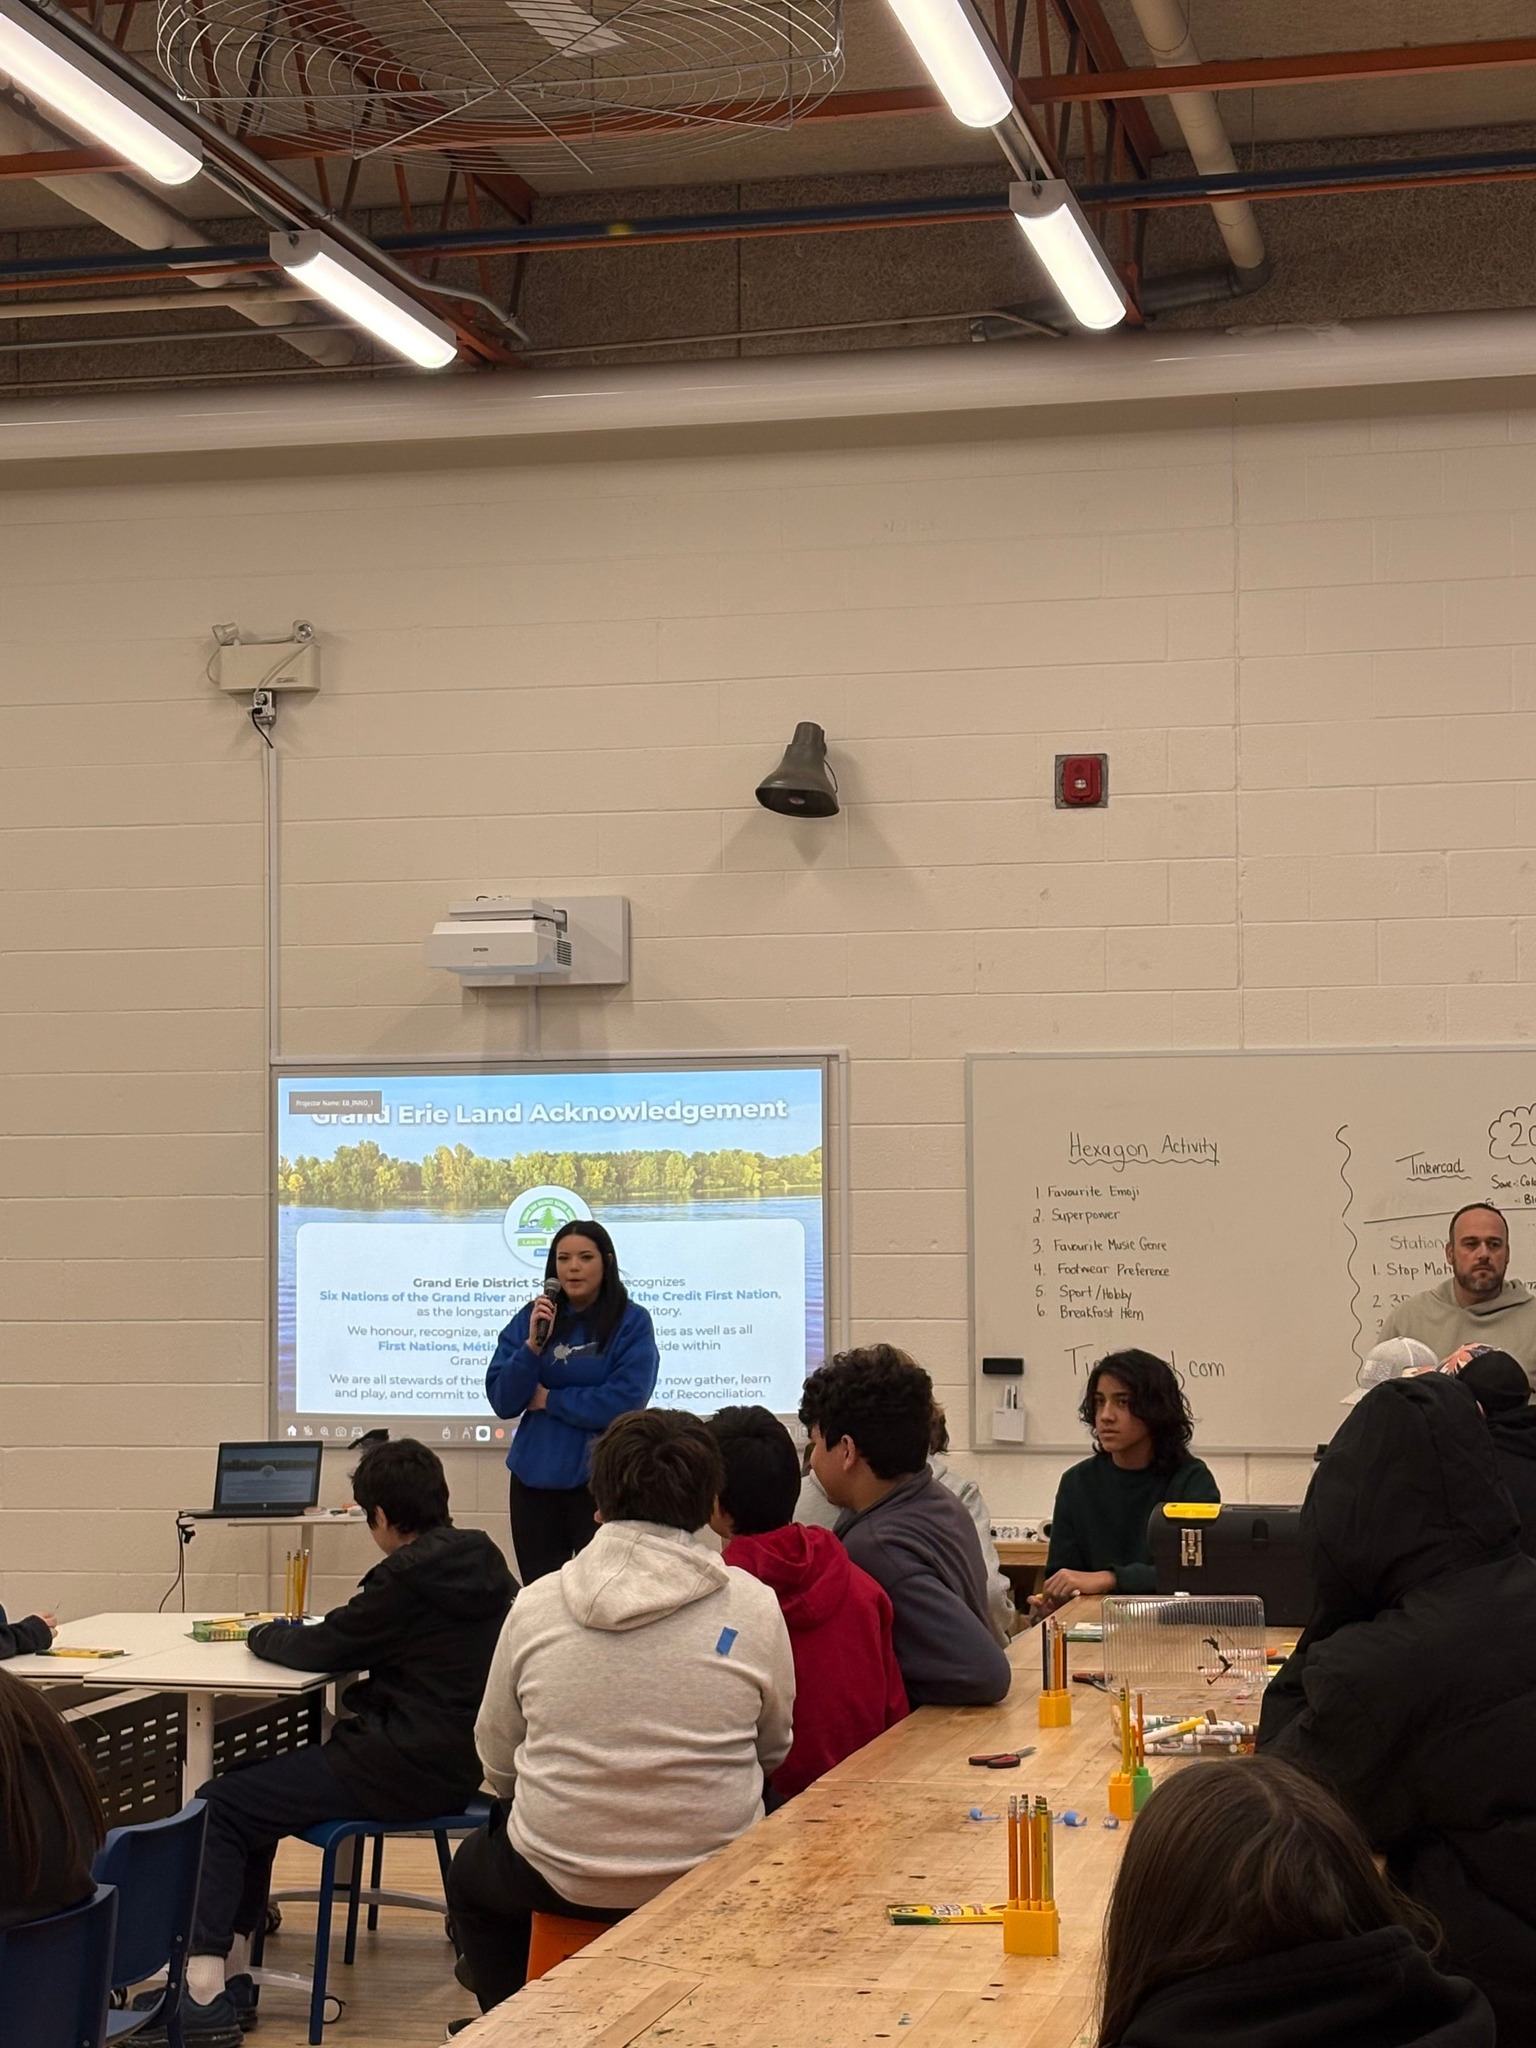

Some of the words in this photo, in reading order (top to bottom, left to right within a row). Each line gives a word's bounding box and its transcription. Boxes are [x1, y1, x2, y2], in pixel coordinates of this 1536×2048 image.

[398, 1104, 449, 1124] Erie
[456, 1103, 522, 1124] Land
[528, 1099, 788, 1125] Acknowledgement
[1069, 1131, 1149, 1172] Hexagon
[1161, 1134, 1218, 1166] Activity
[1395, 1151, 1465, 1175] Tinkercad
[1047, 1185, 1103, 1197] Favourite
[1109, 1185, 1140, 1201] Emoji
[1053, 1239, 1103, 1252] Favourite
[1107, 1239, 1136, 1251] Music
[1139, 1236, 1167, 1251] Genre
[1057, 1263, 1110, 1275] Footwear
[1117, 1262, 1170, 1277] Preference
[1386, 1262, 1419, 1280] Stop
[413, 1278, 451, 1288] Grand
[455, 1278, 480, 1288] Erie
[482, 1278, 530, 1288] District
[319, 1290, 338, 1301] Six
[341, 1291, 389, 1302] Nations
[391, 1292, 405, 1302] of
[406, 1292, 429, 1302] the
[431, 1292, 471, 1302] Grand
[473, 1292, 506, 1302] River
[508, 1292, 533, 1302] and
[638, 1291, 660, 1301] the
[662, 1290, 702, 1301] Credit
[705, 1290, 733, 1300] First
[417, 1308, 430, 1317] as
[432, 1306, 453, 1317] the
[1060, 1304, 1114, 1319] Breakfast
[347, 1325, 368, 1336] We
[370, 1325, 417, 1338] honour,
[419, 1327, 481, 1339] recognize,
[679, 1327, 693, 1336] as
[695, 1325, 720, 1336] well
[723, 1327, 737, 1335] as
[739, 1324, 753, 1335] all
[378, 1341, 406, 1351] First
[409, 1341, 460, 1353] Nations,
[682, 1340, 721, 1351] within
[450, 1356, 488, 1366] Grand
[329, 1374, 349, 1384] We
[351, 1376, 371, 1385] are
[373, 1374, 387, 1385] all
[389, 1375, 444, 1385] stewards
[446, 1375, 458, 1385] of
[665, 1377, 692, 1385] now
[694, 1375, 739, 1387] gather,
[741, 1374, 772, 1385] learn
[334, 1388, 358, 1398] and
[360, 1388, 388, 1400] play,
[390, 1389, 413, 1399] and
[416, 1389, 465, 1400] commit
[467, 1390, 480, 1400] to
[661, 1389, 675, 1399] of
[677, 1388, 766, 1400] Reconciliation.
